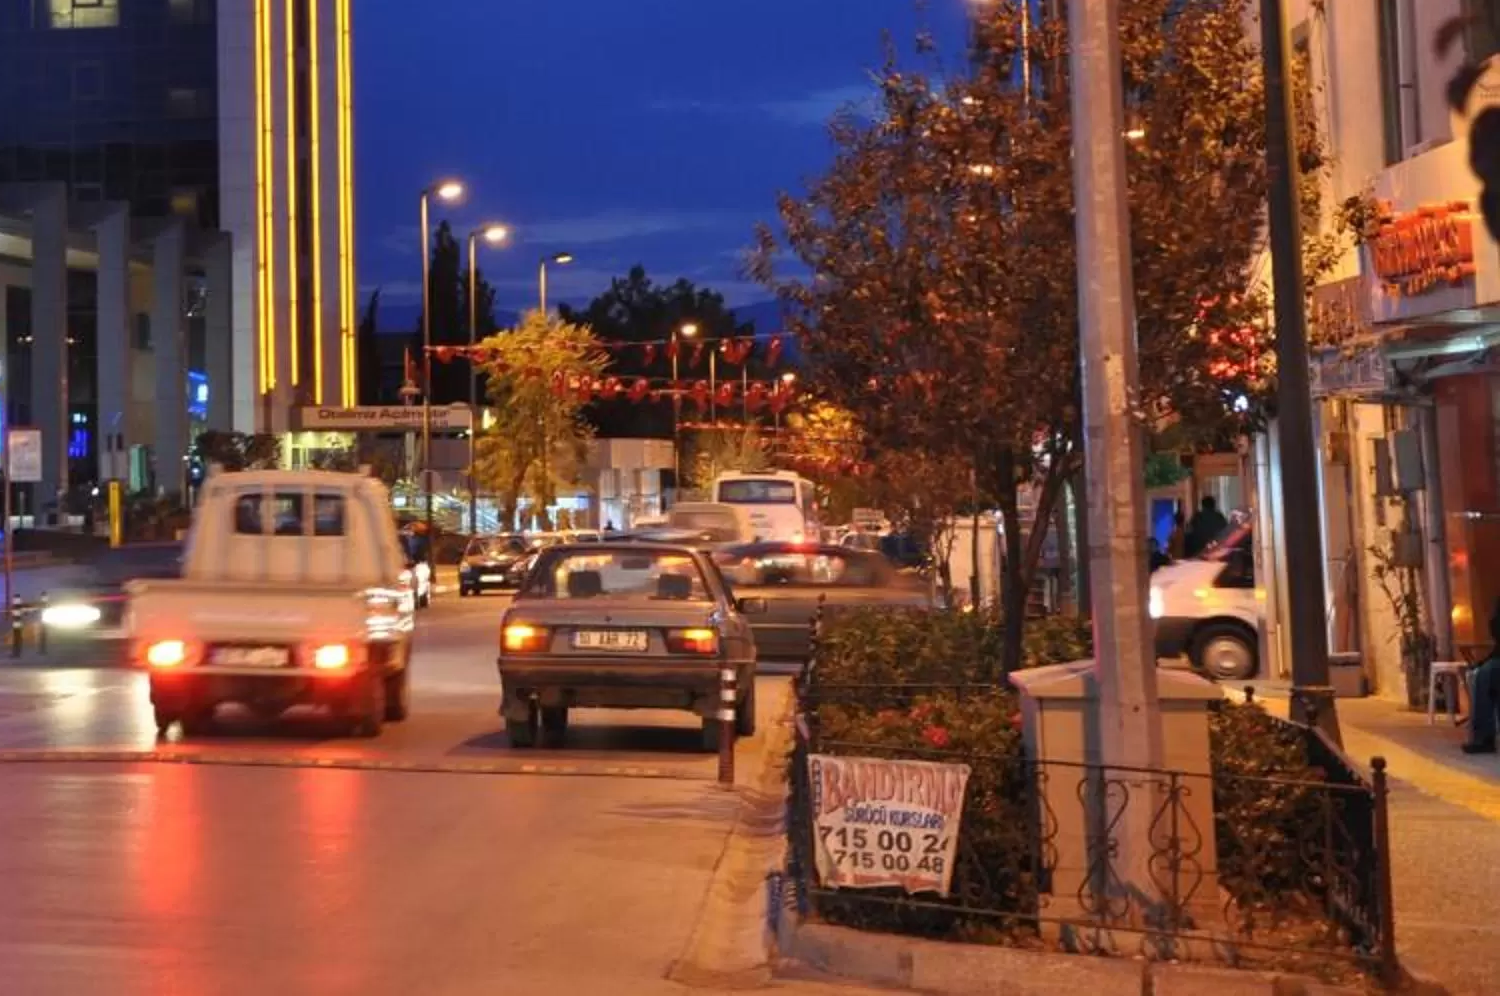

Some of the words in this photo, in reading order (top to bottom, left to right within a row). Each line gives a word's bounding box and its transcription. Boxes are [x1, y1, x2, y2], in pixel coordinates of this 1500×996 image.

[819, 825, 868, 849] 715
[877, 830, 912, 853] 00
[834, 849, 874, 869] 715
[882, 854, 910, 872] 00
[916, 856, 945, 874] 48
